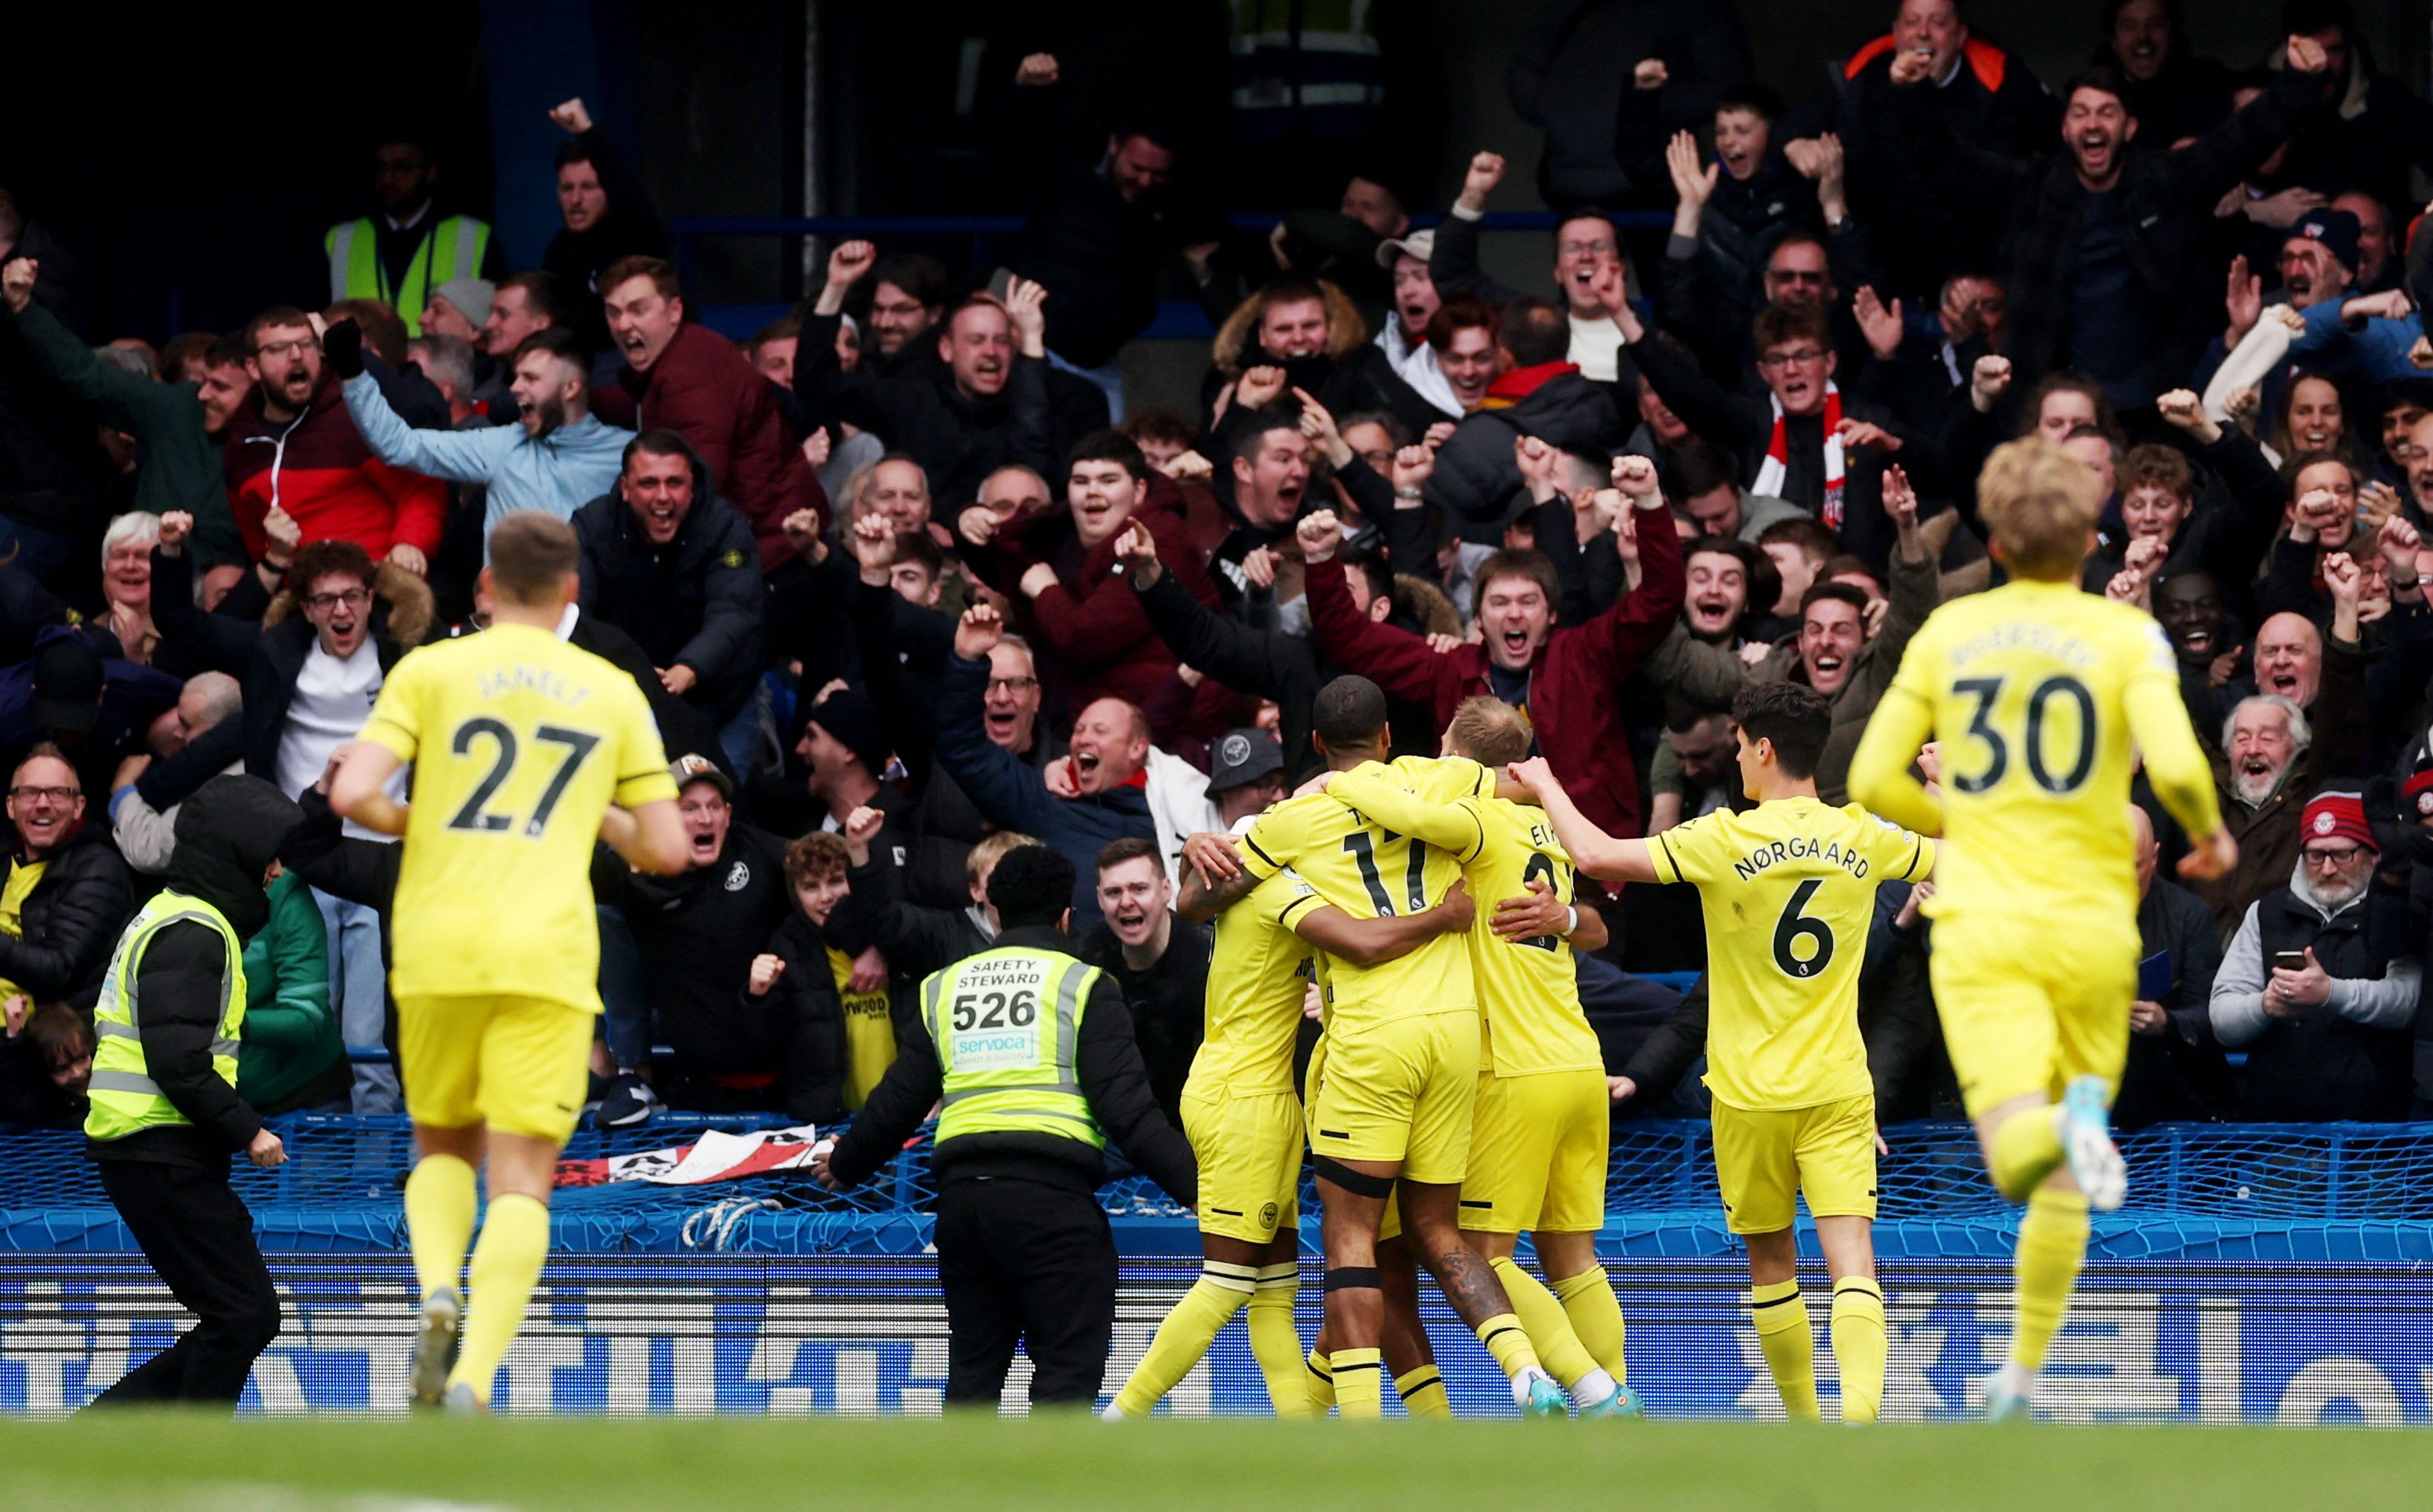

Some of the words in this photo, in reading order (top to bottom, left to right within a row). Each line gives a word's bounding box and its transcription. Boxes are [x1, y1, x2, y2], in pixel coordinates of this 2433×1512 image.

[1952, 675, 2096, 793] 30
[448, 716, 602, 837] 27
[1734, 837, 1869, 881] NØRGAARD
[1773, 879, 1834, 978] 6
[959, 973, 1040, 988] STEWARD
[971, 960, 1036, 973] SAFETY
[953, 990, 1036, 1031] 526
[959, 1036, 1025, 1054] servoca
